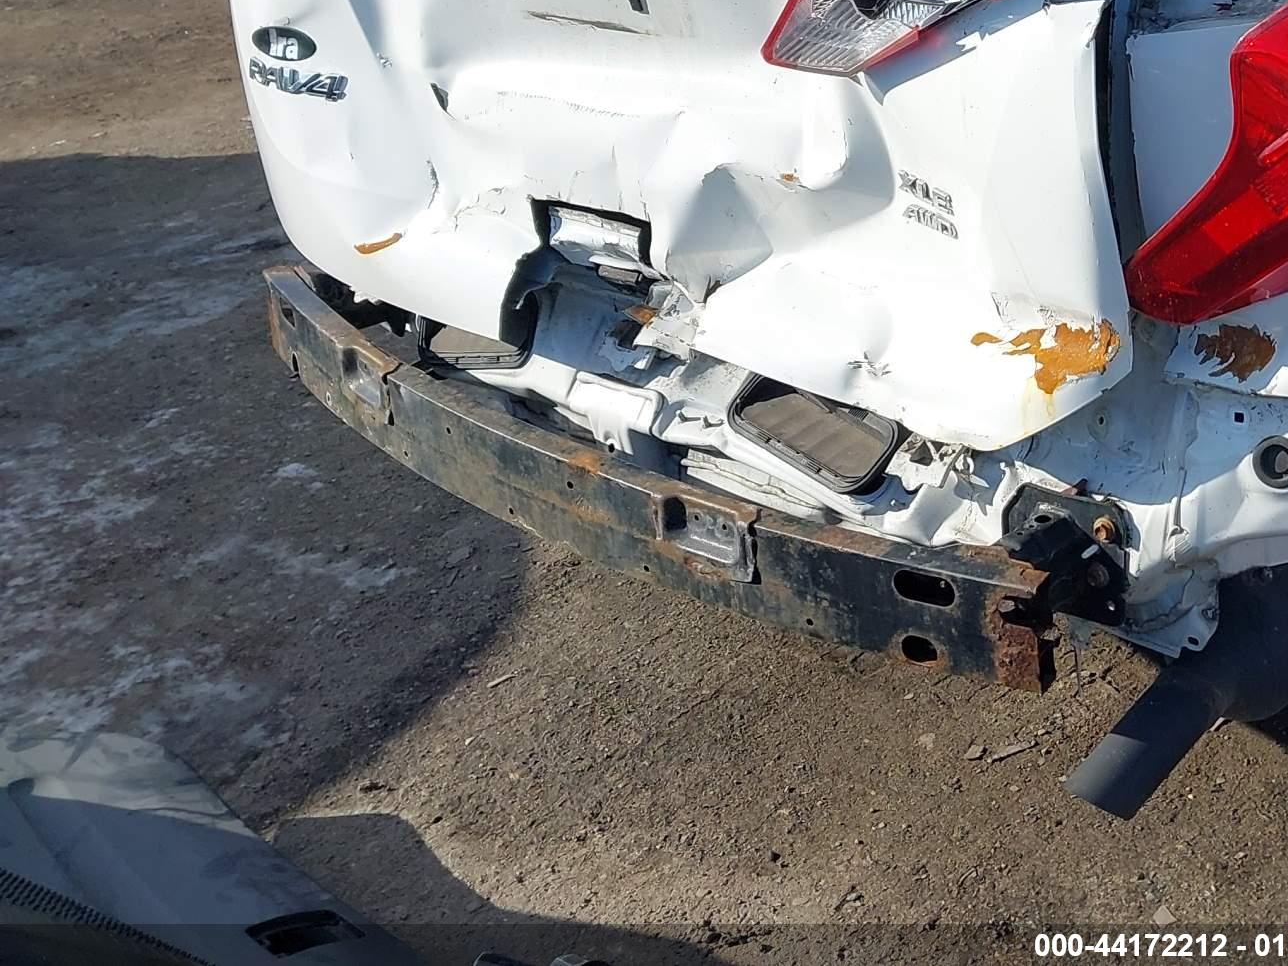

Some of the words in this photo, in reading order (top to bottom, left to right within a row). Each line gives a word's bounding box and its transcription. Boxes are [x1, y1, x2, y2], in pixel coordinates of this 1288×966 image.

[249, 56, 349, 102] RAV4
[898, 169, 955, 216] XLE
[902, 203, 959, 240] AWD
